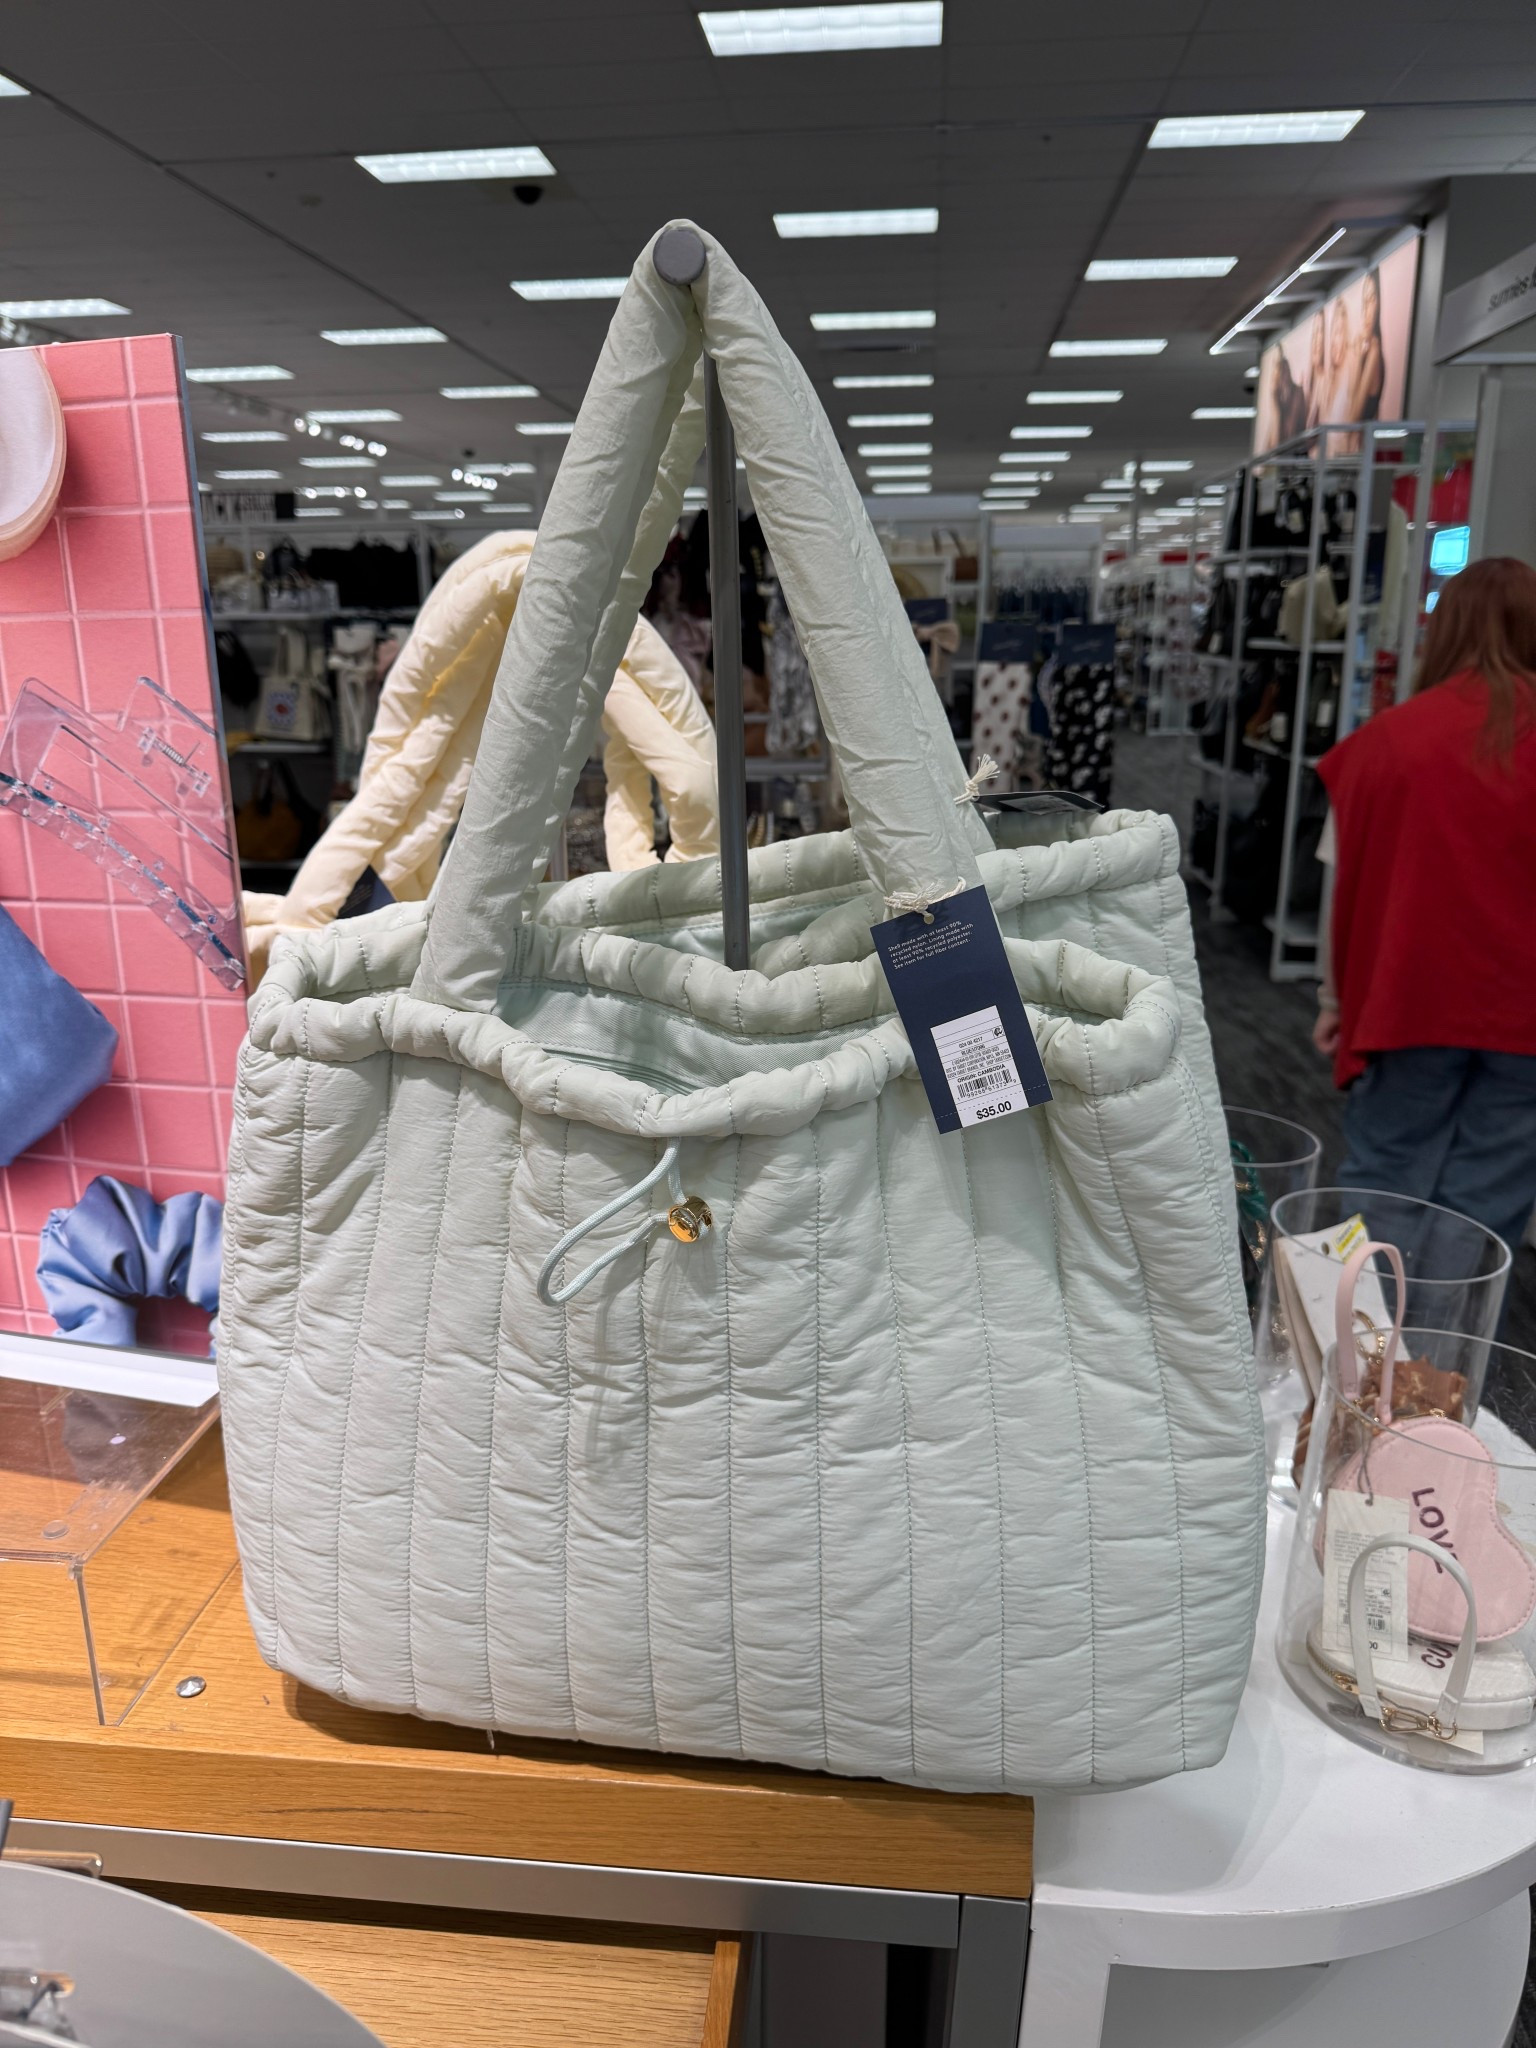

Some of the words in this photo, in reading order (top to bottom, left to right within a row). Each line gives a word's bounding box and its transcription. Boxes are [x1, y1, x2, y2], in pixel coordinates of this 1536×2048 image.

[888, 943, 900, 952] Shell
[902, 938, 916, 946] made
[936, 926, 949, 934] least
[890, 946, 912, 957] recycled
[912, 941, 928, 950] nylon.
[928, 935, 945, 943] Lining
[946, 928, 960, 936] made
[925, 940, 946, 951] recycled
[947, 931, 973, 944] polyester.
[948, 939, 970, 949] content.
[957, 1074, 977, 1082] ORIGIN:
[978, 1064, 1005, 1076] CAMBODIA
[976, 1101, 1011, 1120] $35.00
